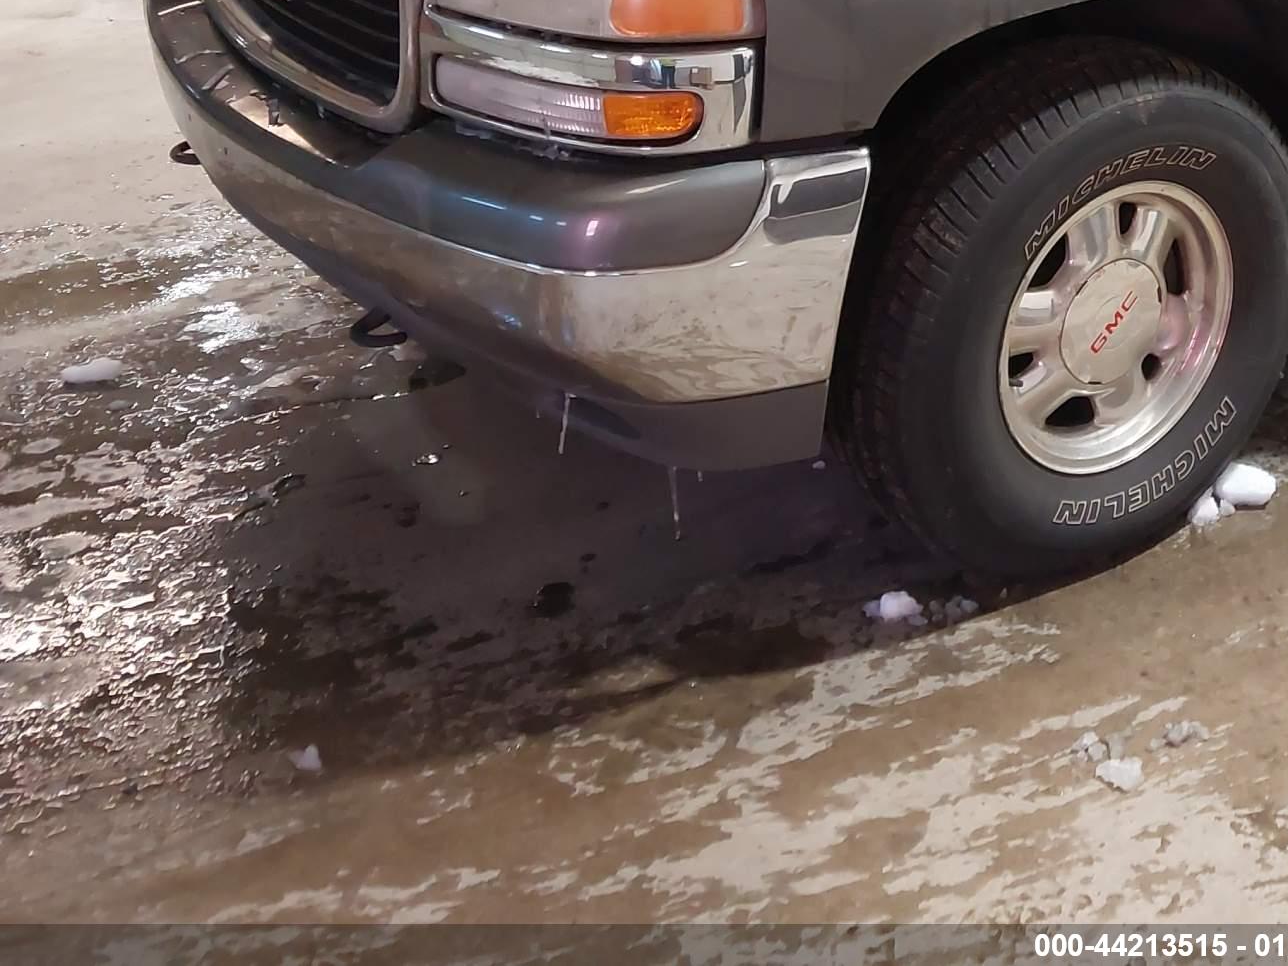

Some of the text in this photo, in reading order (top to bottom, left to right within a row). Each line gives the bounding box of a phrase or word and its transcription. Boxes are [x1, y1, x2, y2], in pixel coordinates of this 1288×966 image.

[1024, 146, 1217, 261] MICHELIN
[1091, 290, 1139, 354] GMC
[1053, 396, 1237, 525] MICHELIN
